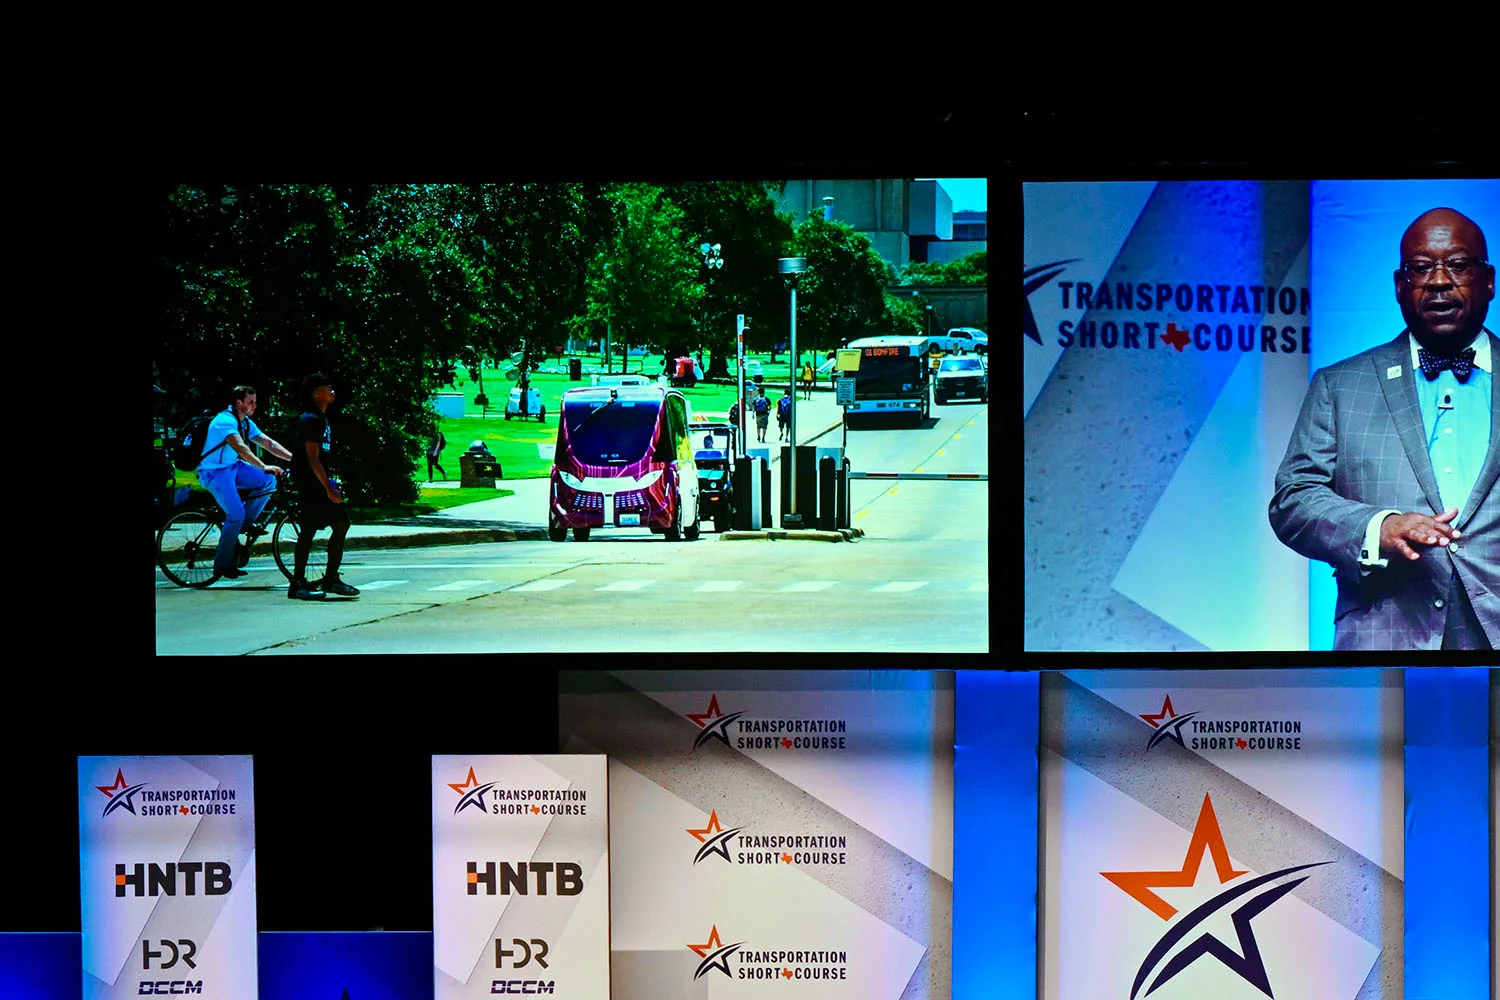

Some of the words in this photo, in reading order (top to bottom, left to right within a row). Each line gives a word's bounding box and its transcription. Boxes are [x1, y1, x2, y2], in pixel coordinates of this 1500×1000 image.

[1057, 320, 1160, 349] SHORT
[738, 720, 846, 733] TRANSPORTATION
[1191, 720, 1301, 734] TRANSPORTATION
[737, 737, 780, 749] SHORT
[794, 737, 846, 749] COURSE
[1191, 737, 1235, 750] SHORT
[1248, 737, 1301, 750] COURSE
[141, 790, 236, 802] TRANSPORTATION
[492, 790, 586, 801] TRANSPORTATION
[141, 805, 178, 816] SHORT
[190, 804, 236, 815] COURSE
[492, 804, 529, 815] SHORT
[542, 804, 586, 815] COURSE
[738, 835, 846, 848] TRANSPORTATION
[738, 852, 780, 865] SHORT
[794, 852, 846, 864] COURSE
[115, 862, 233, 897] HNTB
[466, 862, 584, 896] HNTB
[143, 939, 197, 970] HDR
[495, 938, 549, 969] HDR
[739, 951, 847, 964] TRANSPORTATION
[738, 968, 780, 980] SHORT
[794, 968, 847, 980] COURSE
[138, 980, 203, 995] DCCM
[491, 980, 555, 994] DCCM
